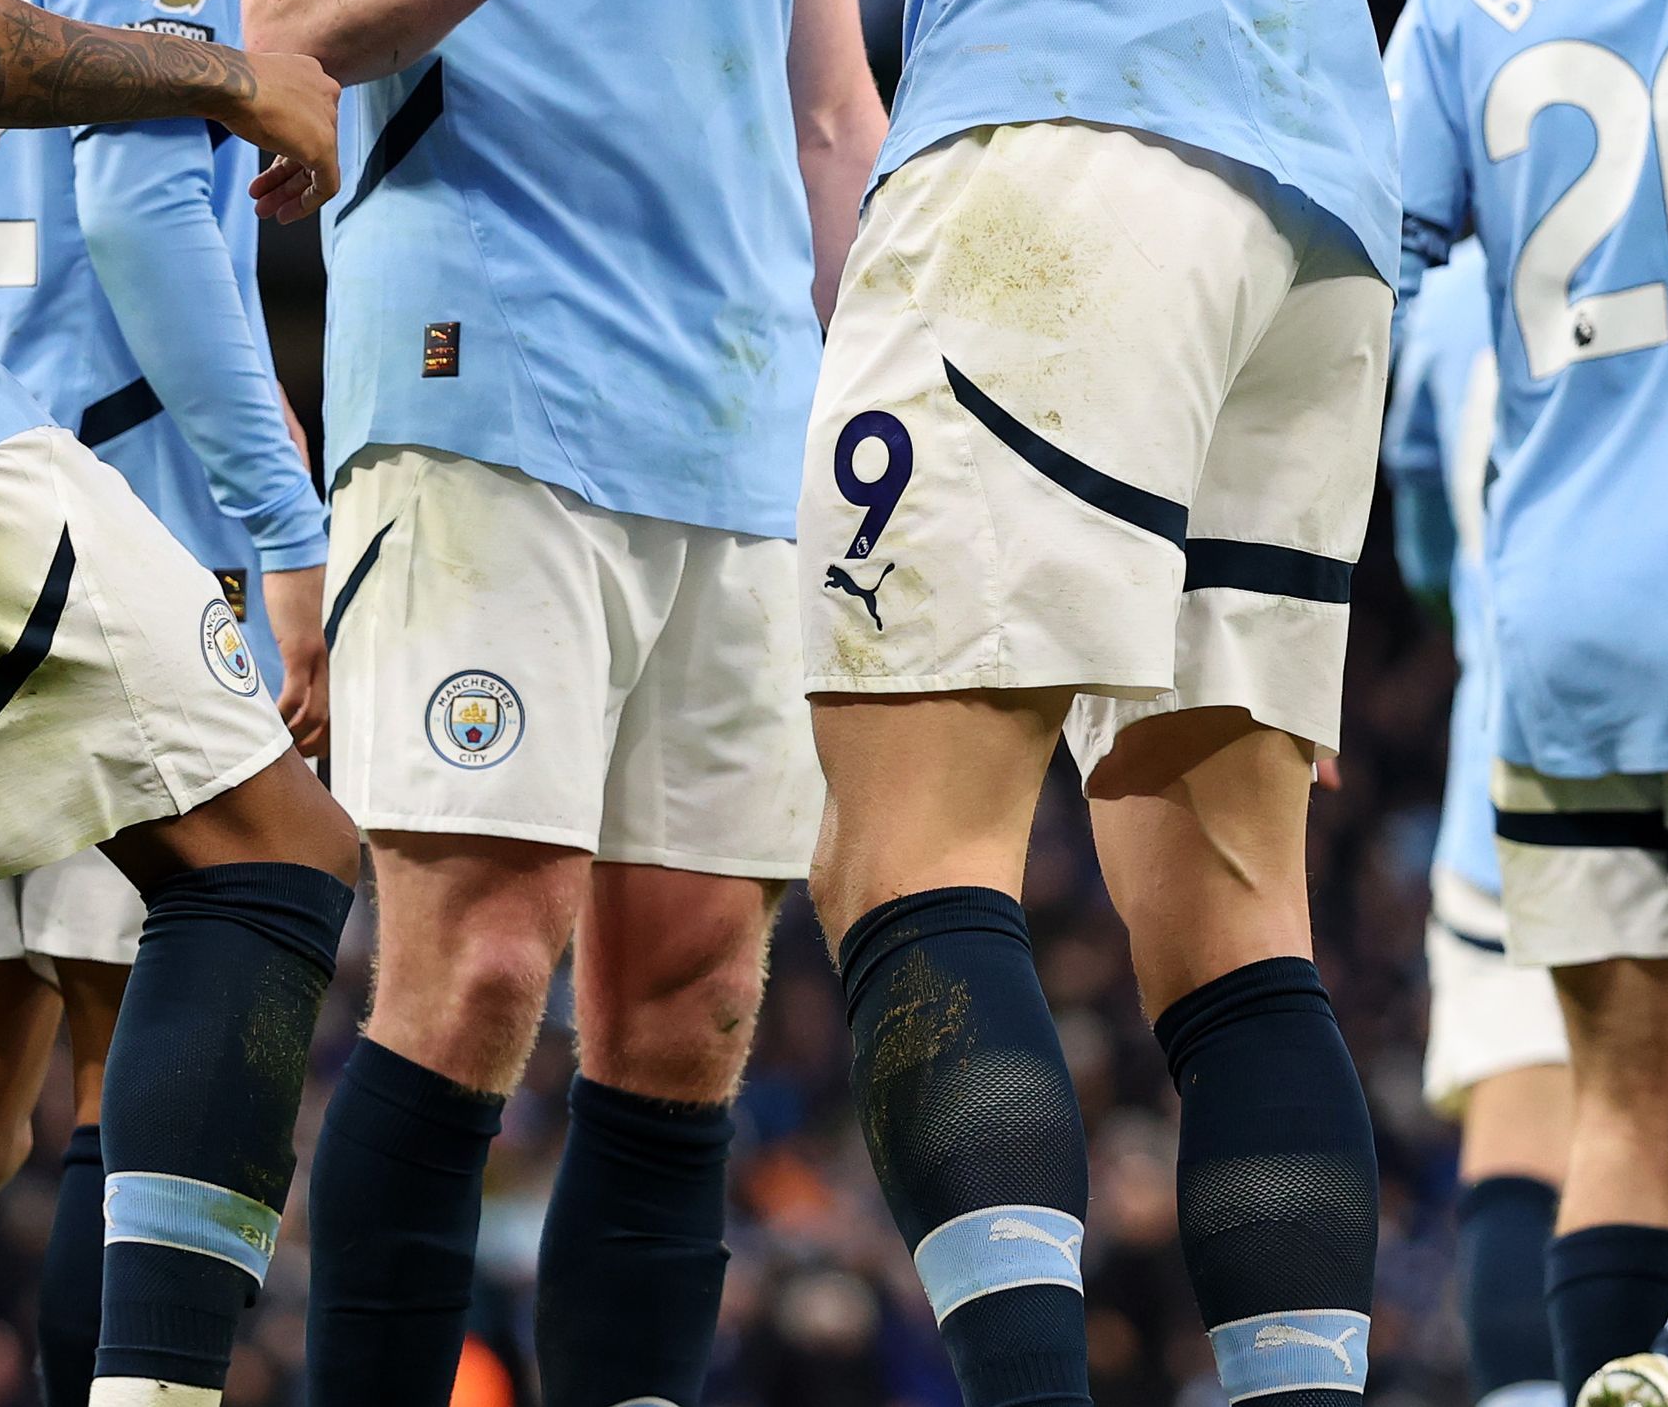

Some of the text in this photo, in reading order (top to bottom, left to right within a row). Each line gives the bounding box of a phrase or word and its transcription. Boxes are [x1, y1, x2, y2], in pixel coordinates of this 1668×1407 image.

[834, 410, 913, 560] 9
[438, 678, 514, 709] MANCHESTER
[459, 753, 488, 763] CITY
